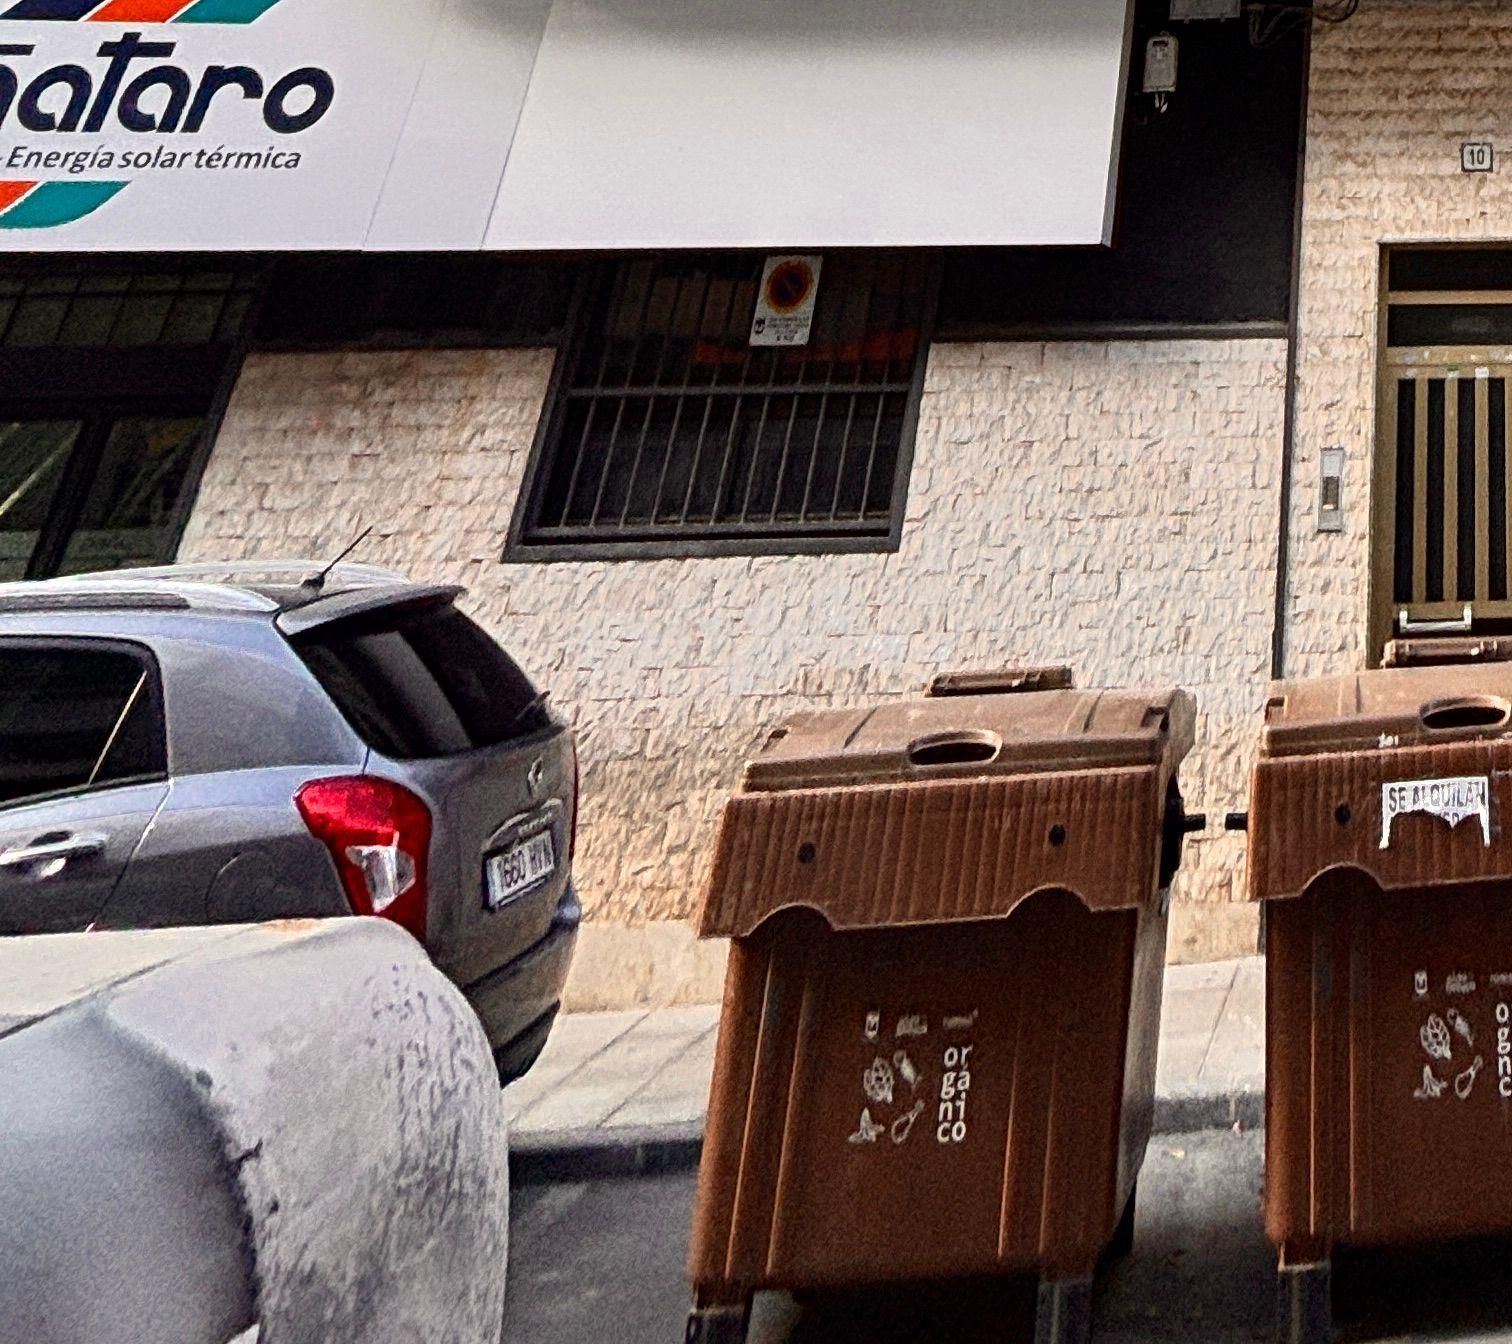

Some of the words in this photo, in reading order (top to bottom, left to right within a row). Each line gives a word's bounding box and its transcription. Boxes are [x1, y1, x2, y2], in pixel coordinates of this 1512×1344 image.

[0, 31, 335, 134] ataro
[8, 145, 114, 174] Energía
[120, 145, 193, 169] solar
[194, 145, 302, 170] térmica
[1470, 148, 1485, 166] 10
[1388, 786, 1407, 813] SE
